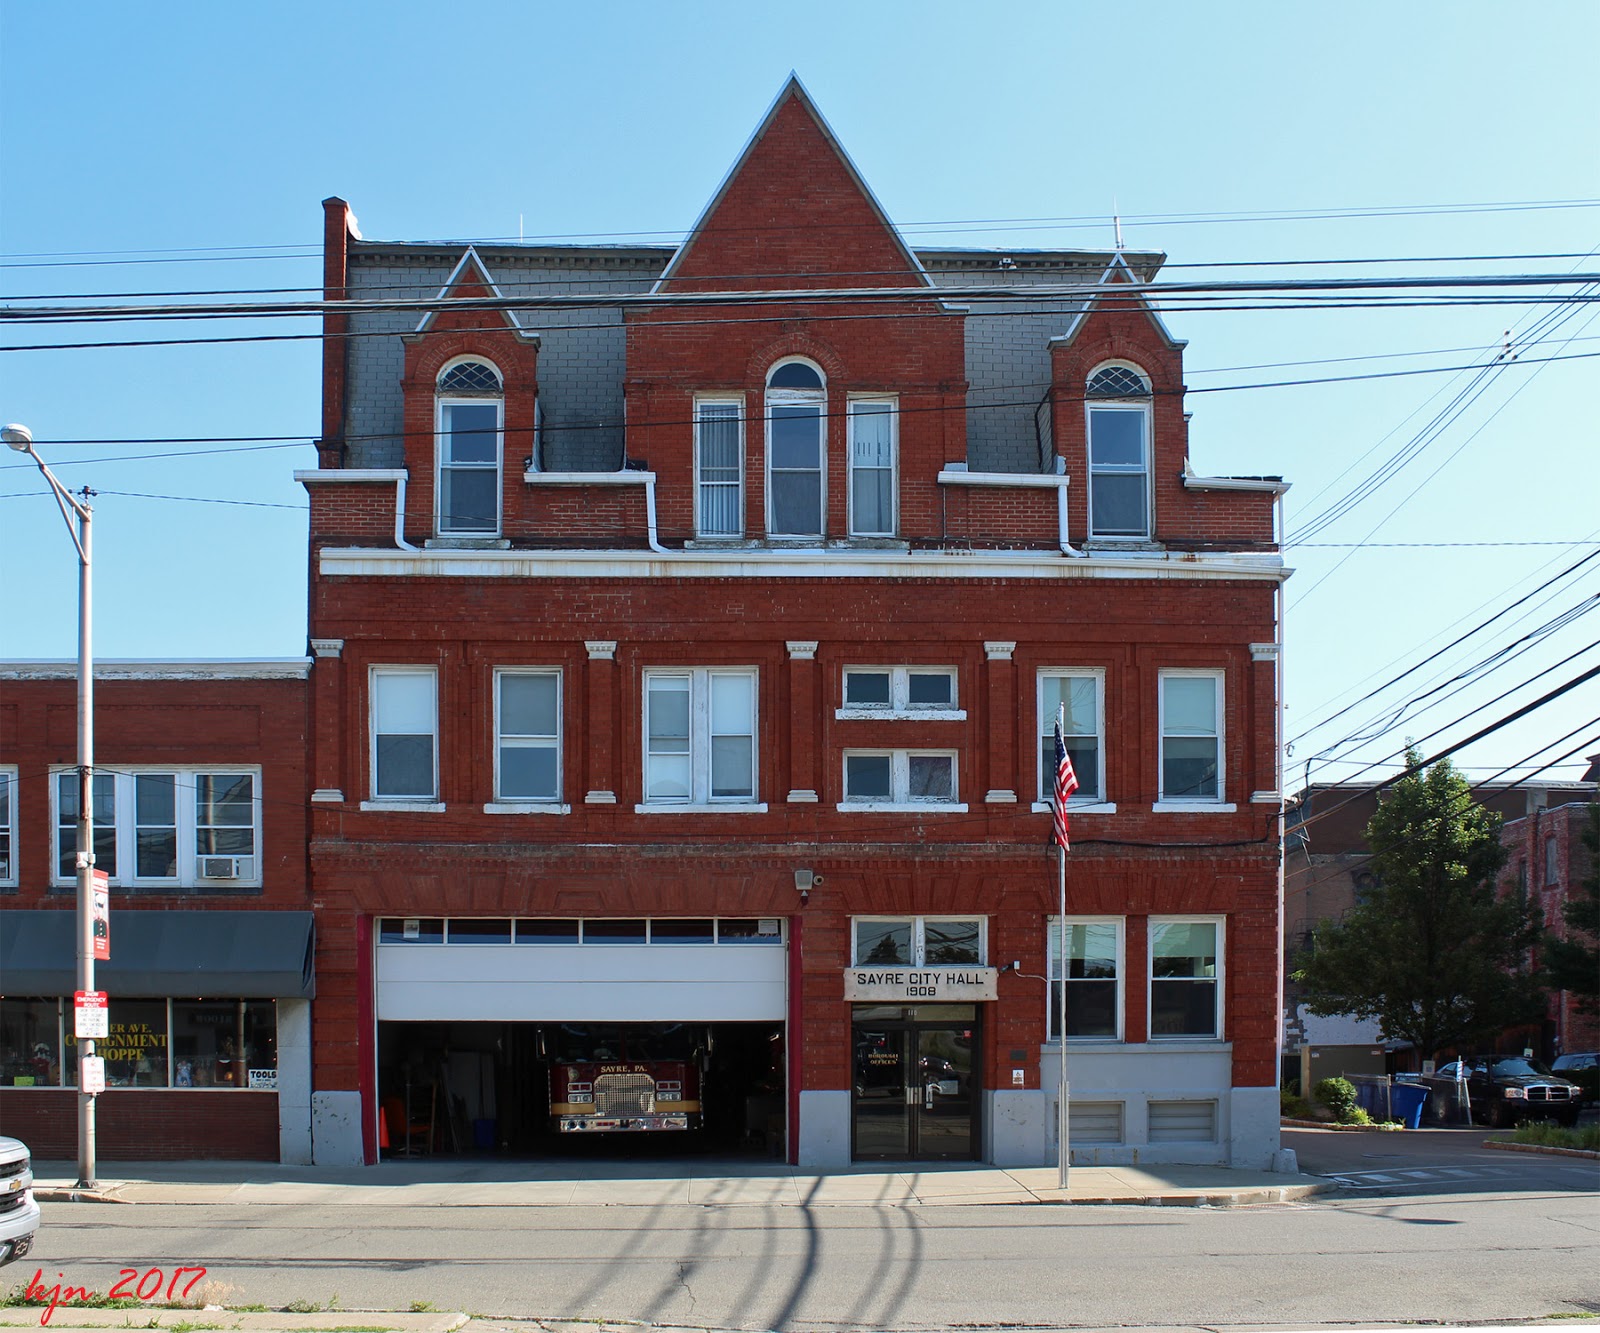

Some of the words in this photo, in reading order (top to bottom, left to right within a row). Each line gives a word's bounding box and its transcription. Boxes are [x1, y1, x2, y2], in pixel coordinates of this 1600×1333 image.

[857, 973, 904, 985] SAYRE
[909, 973, 941, 985] CITY
[946, 973, 984, 985] HALL
[906, 986, 937, 996] 1908
[128, 1024, 152, 1033] AVE.
[65, 1033, 168, 1047] CSIGNMENT
[97, 1048, 145, 1060] HOPPE
[601, 1065, 630, 1073] SAYRE,
